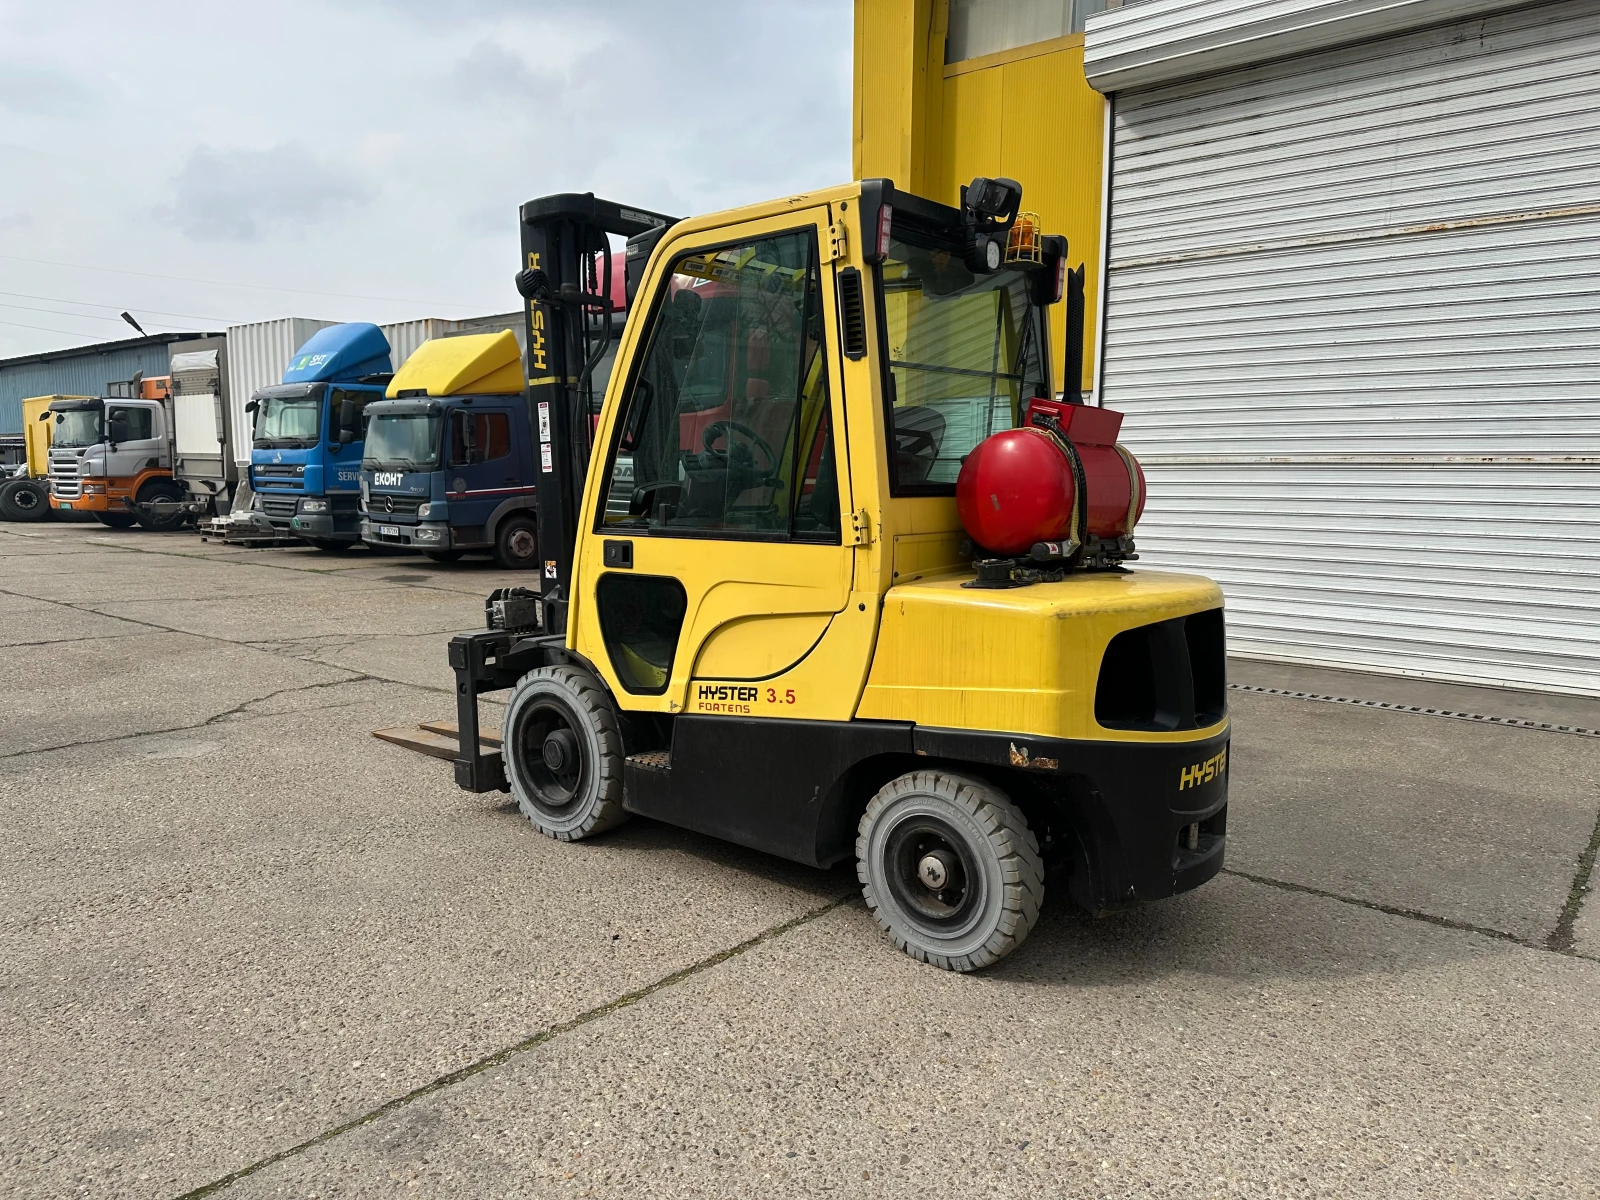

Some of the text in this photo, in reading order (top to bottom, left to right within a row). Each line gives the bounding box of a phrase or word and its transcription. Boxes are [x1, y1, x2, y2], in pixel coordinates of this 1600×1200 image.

[528, 251, 547, 370] HYSTR
[698, 685, 796, 705] HYSTER 3.5
[698, 702, 751, 714] FORTENS
